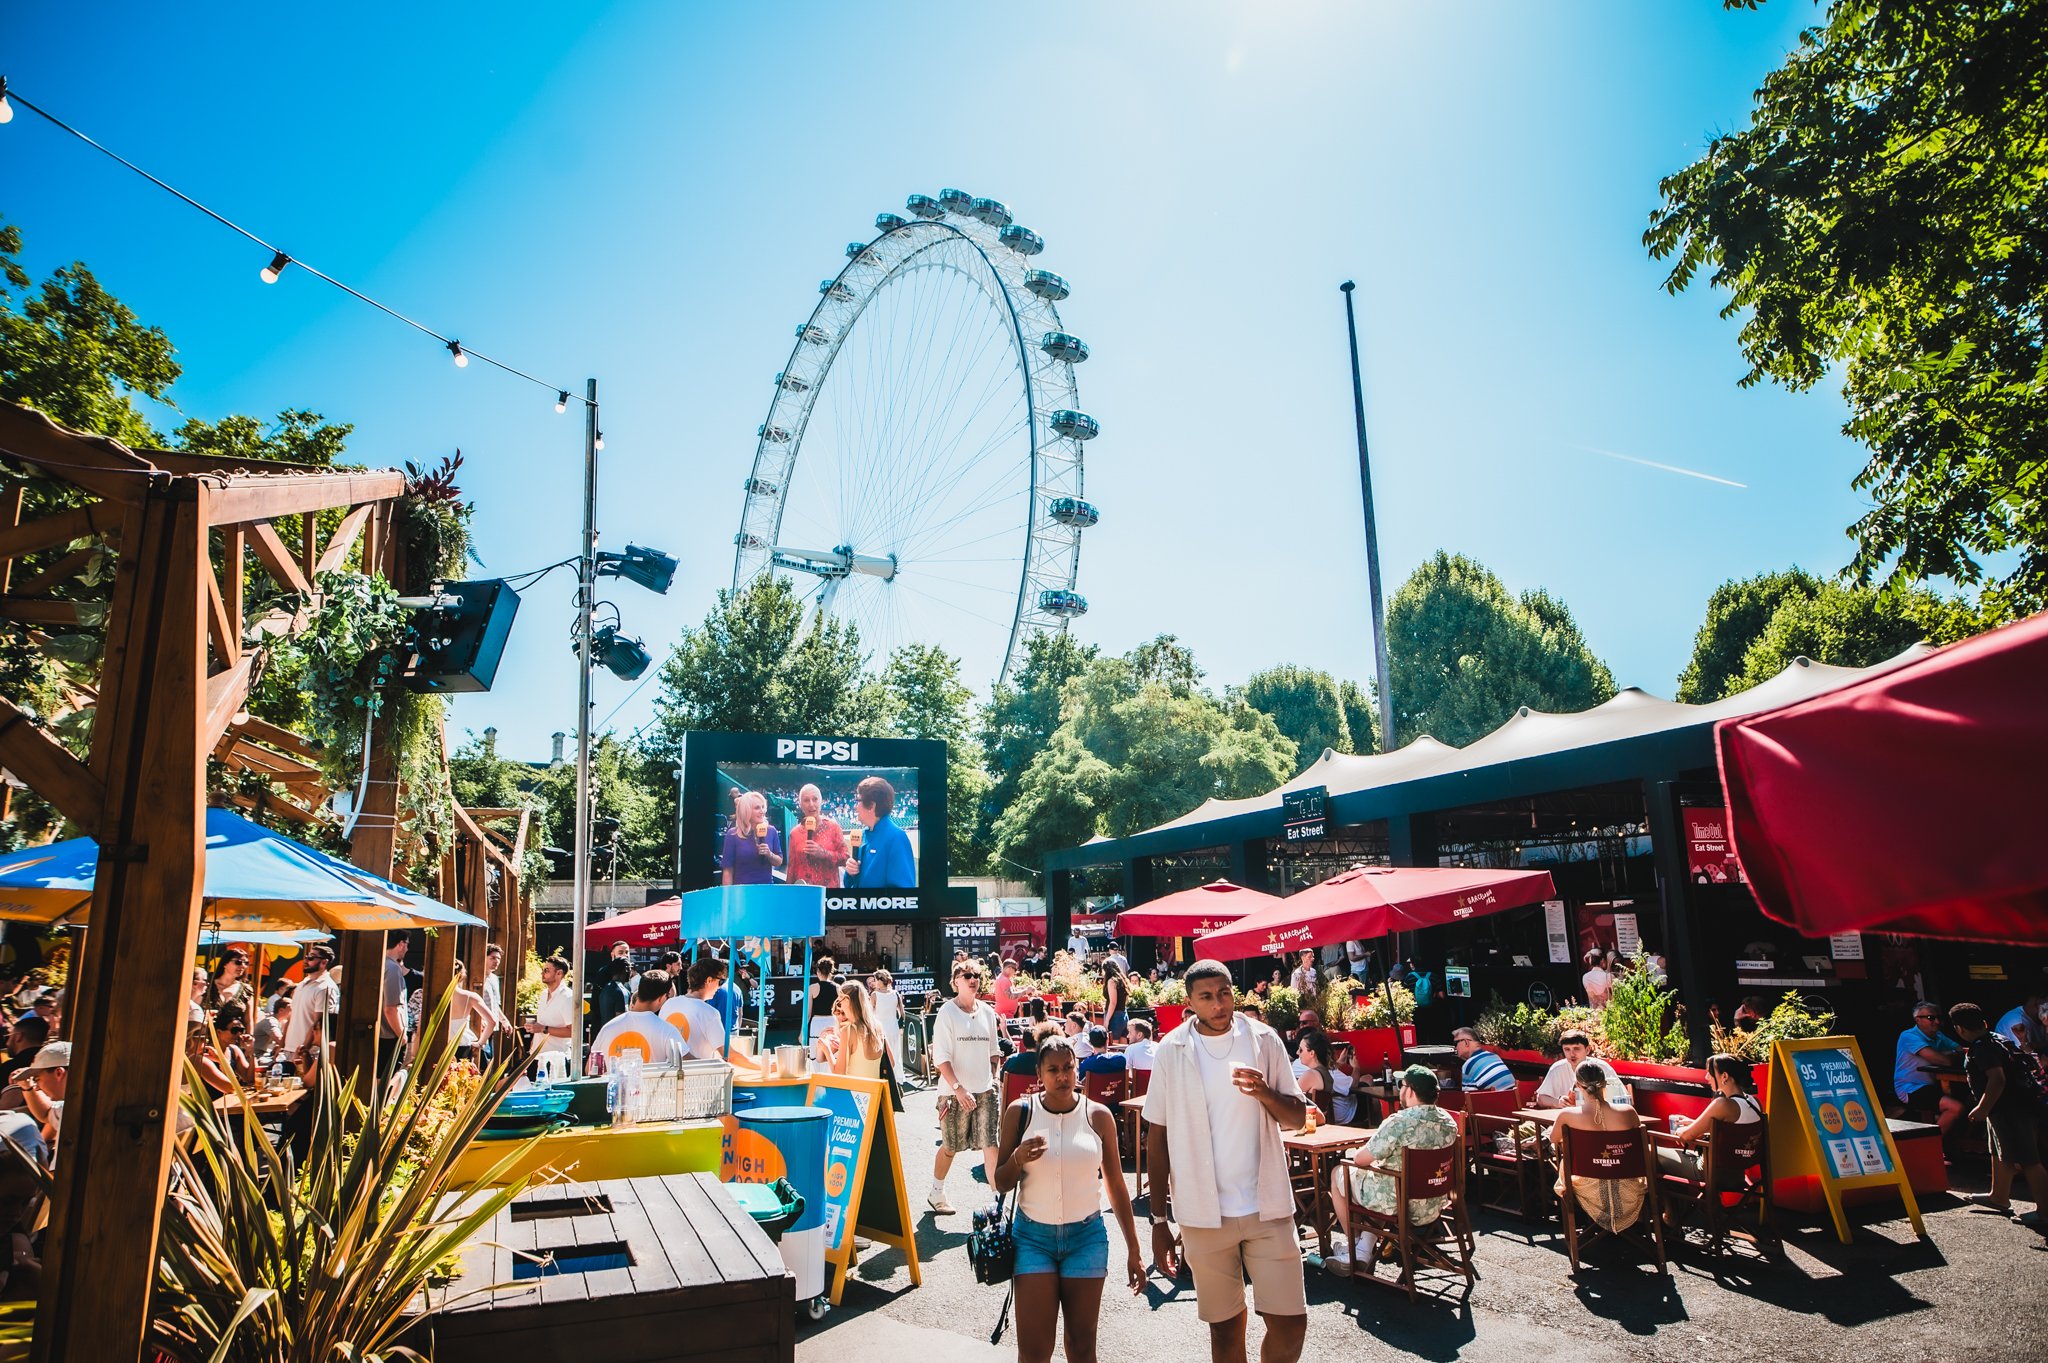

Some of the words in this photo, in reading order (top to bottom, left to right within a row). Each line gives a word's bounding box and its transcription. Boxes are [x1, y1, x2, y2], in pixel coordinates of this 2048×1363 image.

[777, 739, 859, 761] PEPSI
[1288, 828, 1299, 840] Eat
[1301, 824, 1324, 837] Street
[860, 897, 918, 910] MORE
[1453, 906, 1474, 917] ESTRELLA
[946, 926, 996, 937] HOME
[1262, 942, 1285, 952] ESTRELLA
[1801, 1064, 1817, 1080] 95
[1821, 1061, 1851, 1071] PREMIUM
[1826, 1071, 1856, 1086] Vodka
[833, 1116, 860, 1129] PREMIUM
[831, 1125, 857, 1145] Vodka
